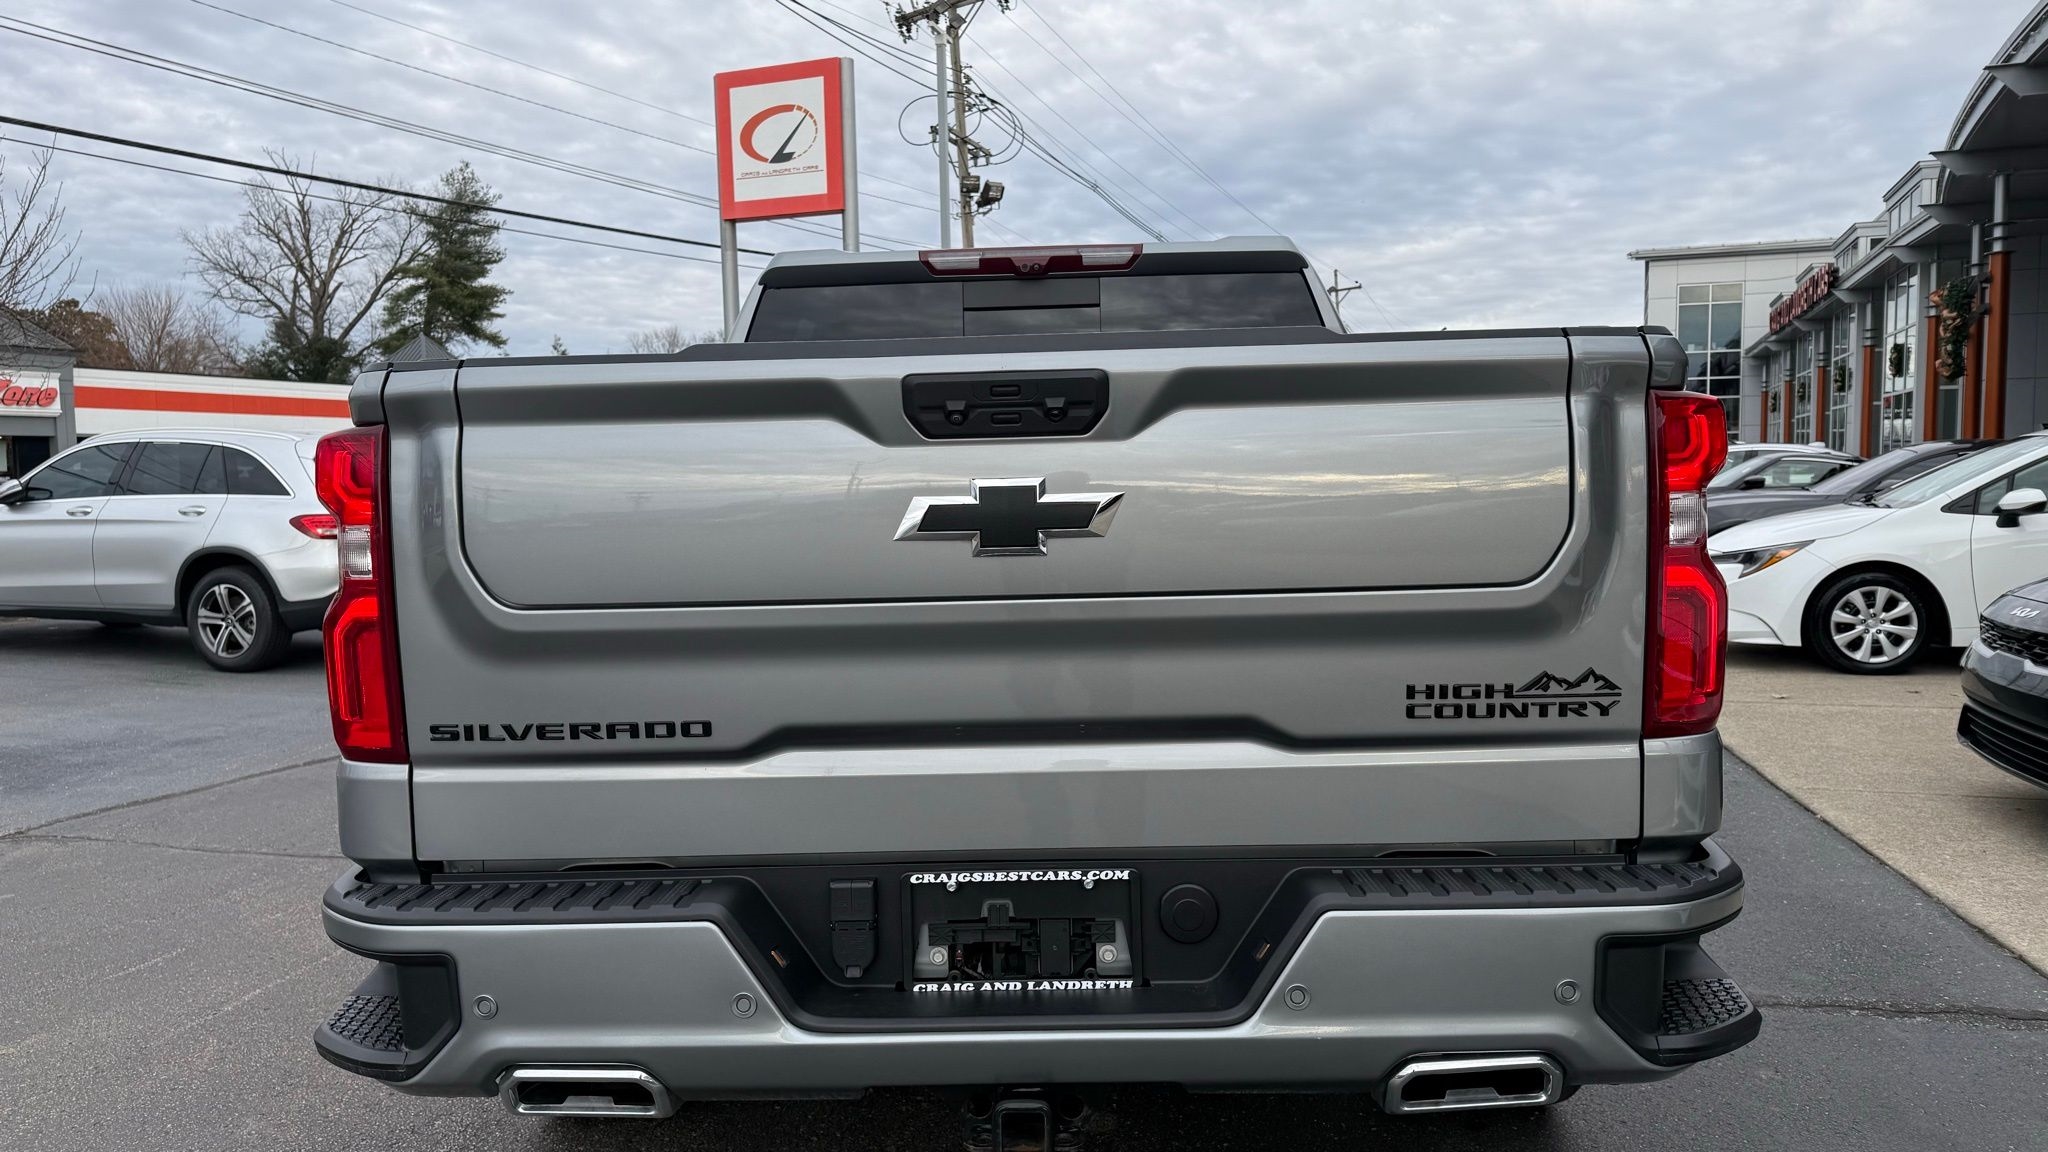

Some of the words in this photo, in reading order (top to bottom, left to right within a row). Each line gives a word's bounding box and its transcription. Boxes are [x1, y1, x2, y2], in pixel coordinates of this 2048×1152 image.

[1406, 683, 1514, 699] HIGH
[1406, 700, 1621, 719] COUNTRY
[429, 720, 712, 742] SILVERADO
[909, 870, 1130, 884] CRAIGSBESTCARS.COM
[912, 982, 975, 992] CRAIG
[980, 981, 1022, 991] AND
[1027, 980, 1134, 990] LANDRETH
